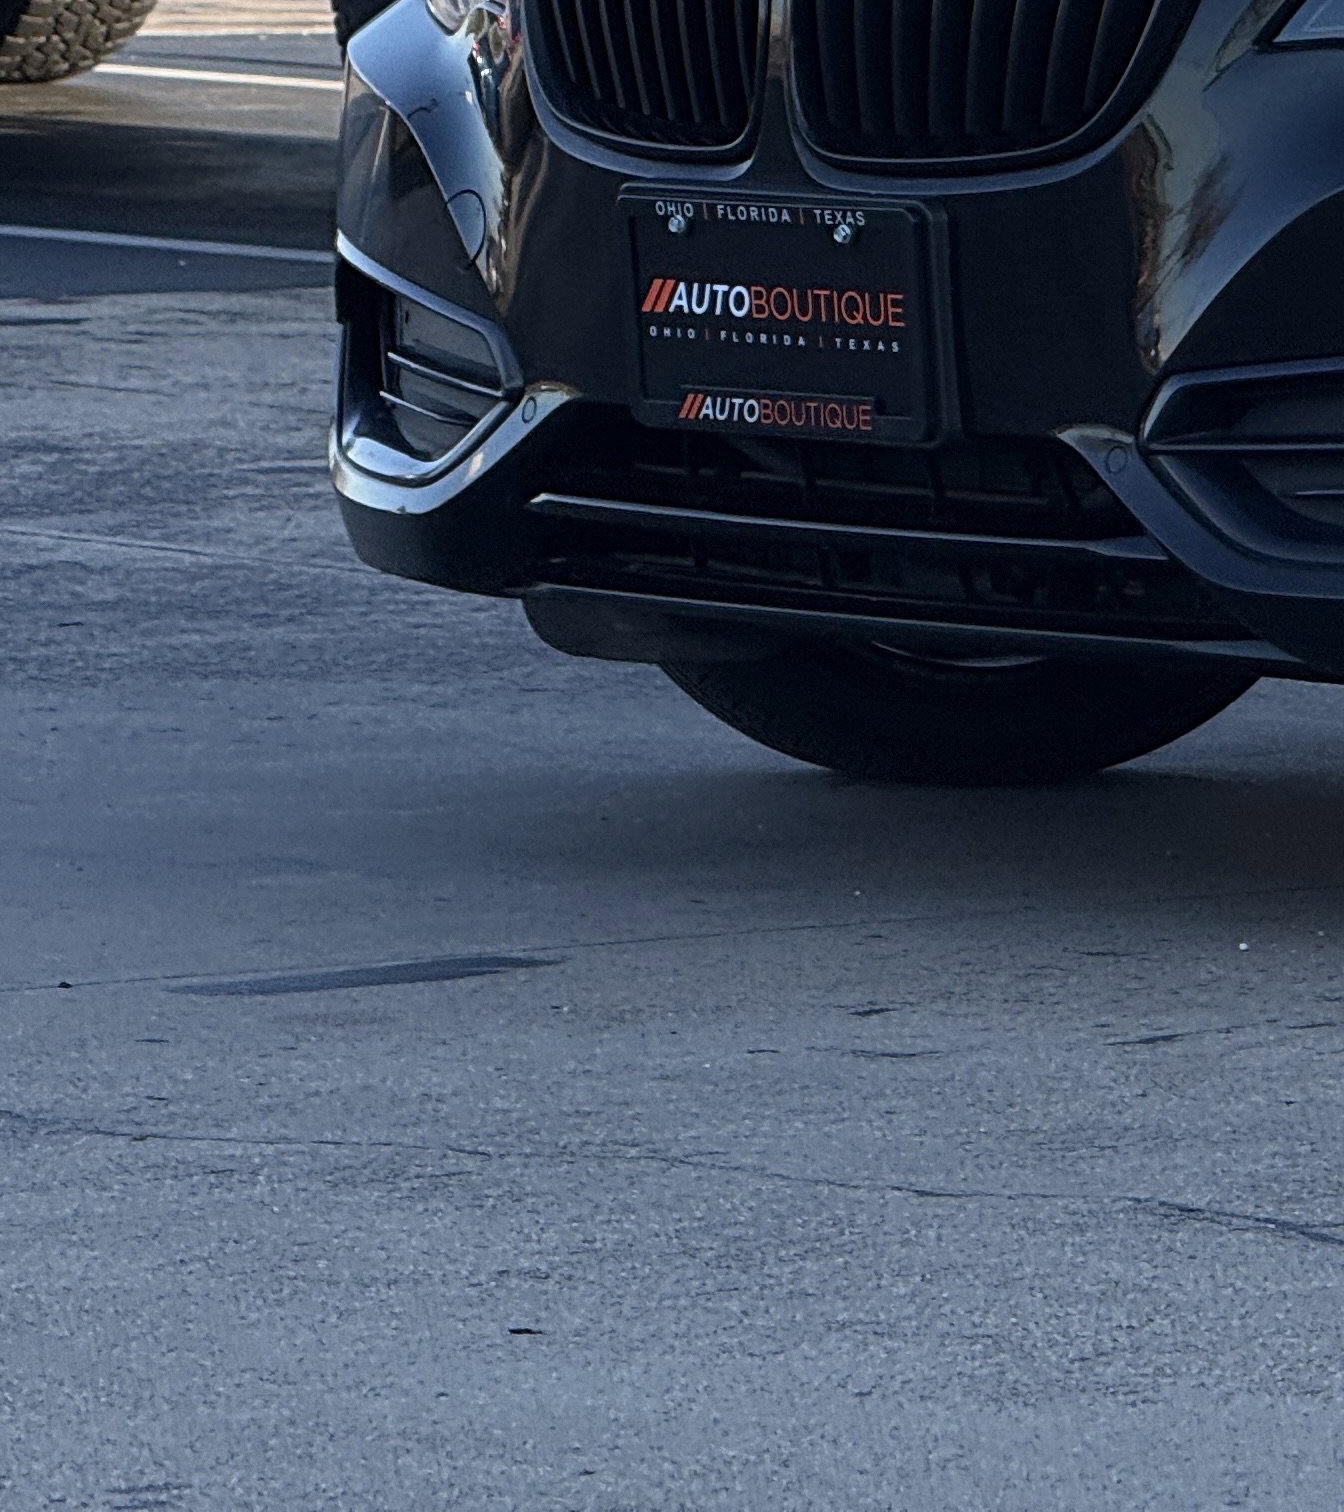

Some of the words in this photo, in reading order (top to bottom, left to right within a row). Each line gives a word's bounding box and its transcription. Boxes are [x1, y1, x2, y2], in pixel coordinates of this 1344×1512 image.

[655, 201, 694, 217] OHIO
[716, 204, 792, 223] FLORIDA
[813, 209, 866, 226] TEXAS
[649, 325, 695, 339] OHIO
[720, 331, 806, 347] FLORIDA
[835, 338, 899, 353] TEXAS
